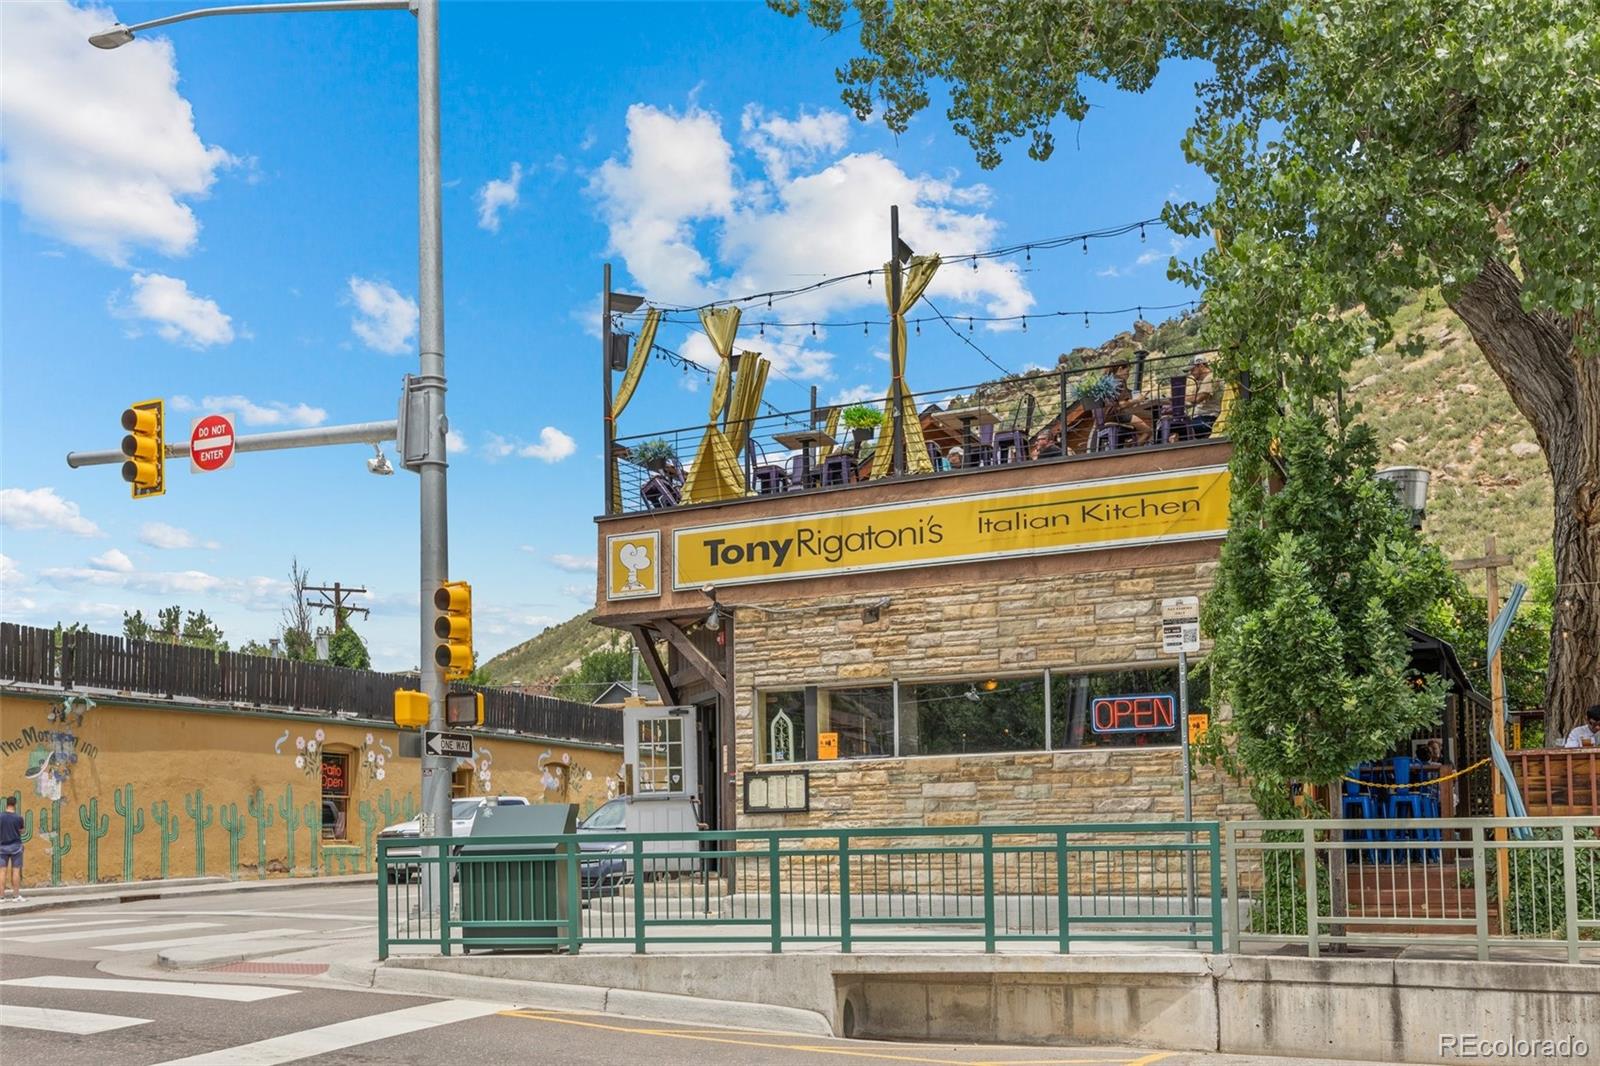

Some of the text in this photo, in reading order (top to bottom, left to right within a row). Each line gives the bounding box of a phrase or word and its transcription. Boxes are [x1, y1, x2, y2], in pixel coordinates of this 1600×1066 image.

[199, 424, 226, 437] DO NOT
[201, 450, 224, 461] ENTER
[978, 498, 1200, 534] Italian Kitchen
[703, 515, 943, 568] Tony Rigatoni's
[1094, 698, 1173, 730] OPEN
[0, 737, 24, 758] The
[441, 739, 469, 751] ONE WAY
[320, 763, 342, 777] Patio
[321, 775, 344, 790] Open
